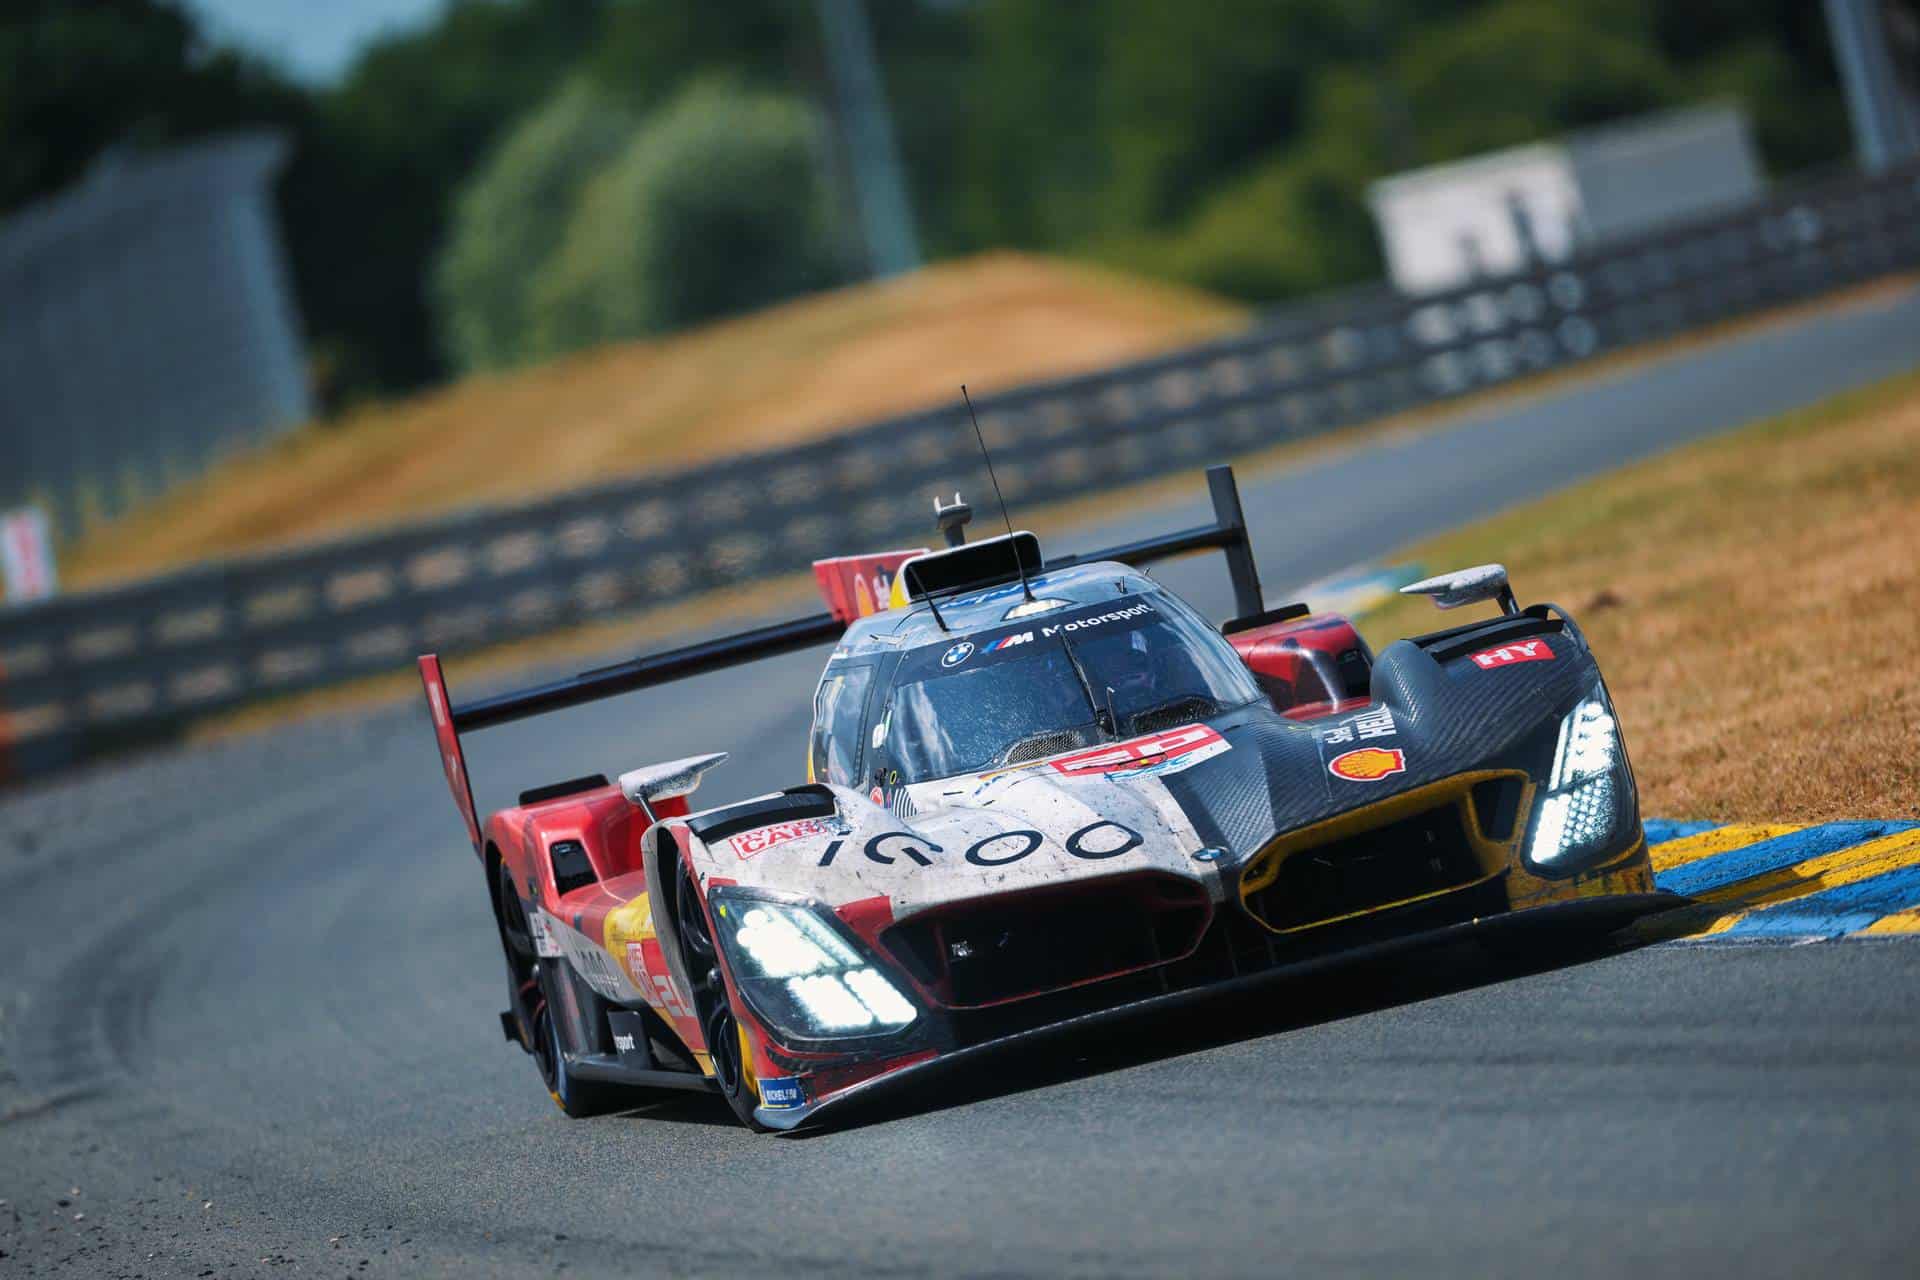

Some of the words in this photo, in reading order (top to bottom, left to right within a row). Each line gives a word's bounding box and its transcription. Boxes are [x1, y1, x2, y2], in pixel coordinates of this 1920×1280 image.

[1041, 603, 1154, 637] Motorsport
[1476, 641, 1538, 666] HY
[741, 821, 819, 853] CAR
